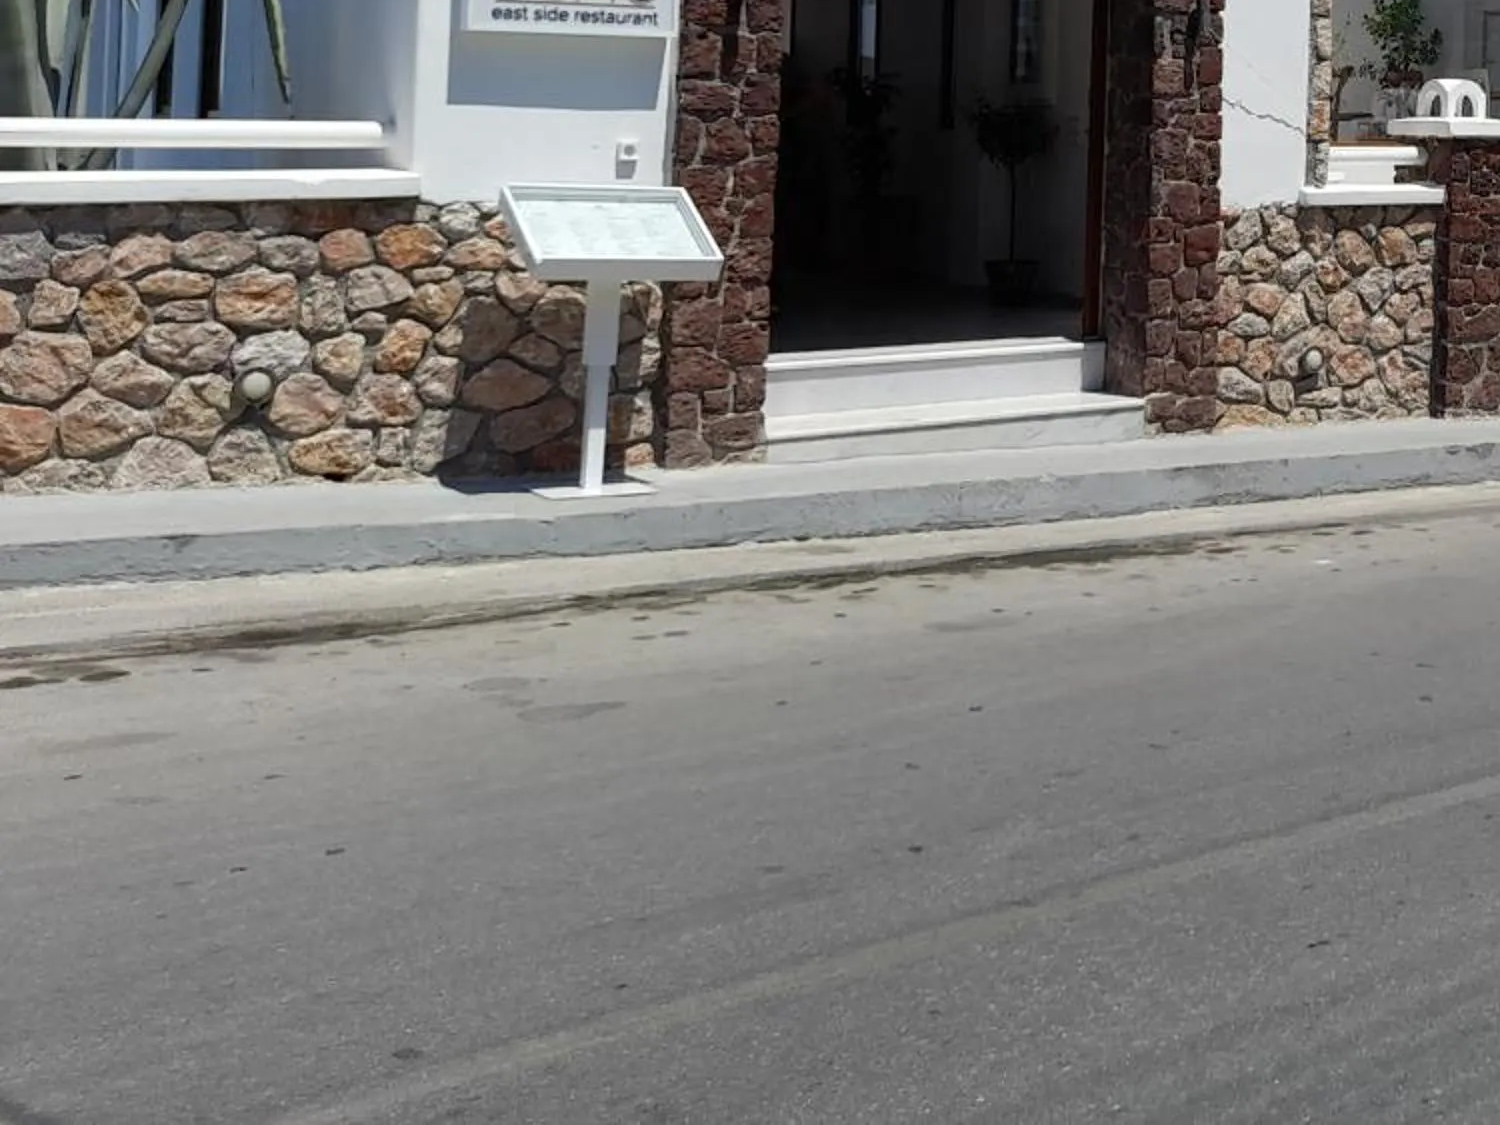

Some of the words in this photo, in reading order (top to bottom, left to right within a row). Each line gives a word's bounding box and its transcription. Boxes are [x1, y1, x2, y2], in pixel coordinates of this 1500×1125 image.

[491, 6, 528, 22] east
[533, 7, 570, 23] side
[574, 10, 659, 26] restaurant
